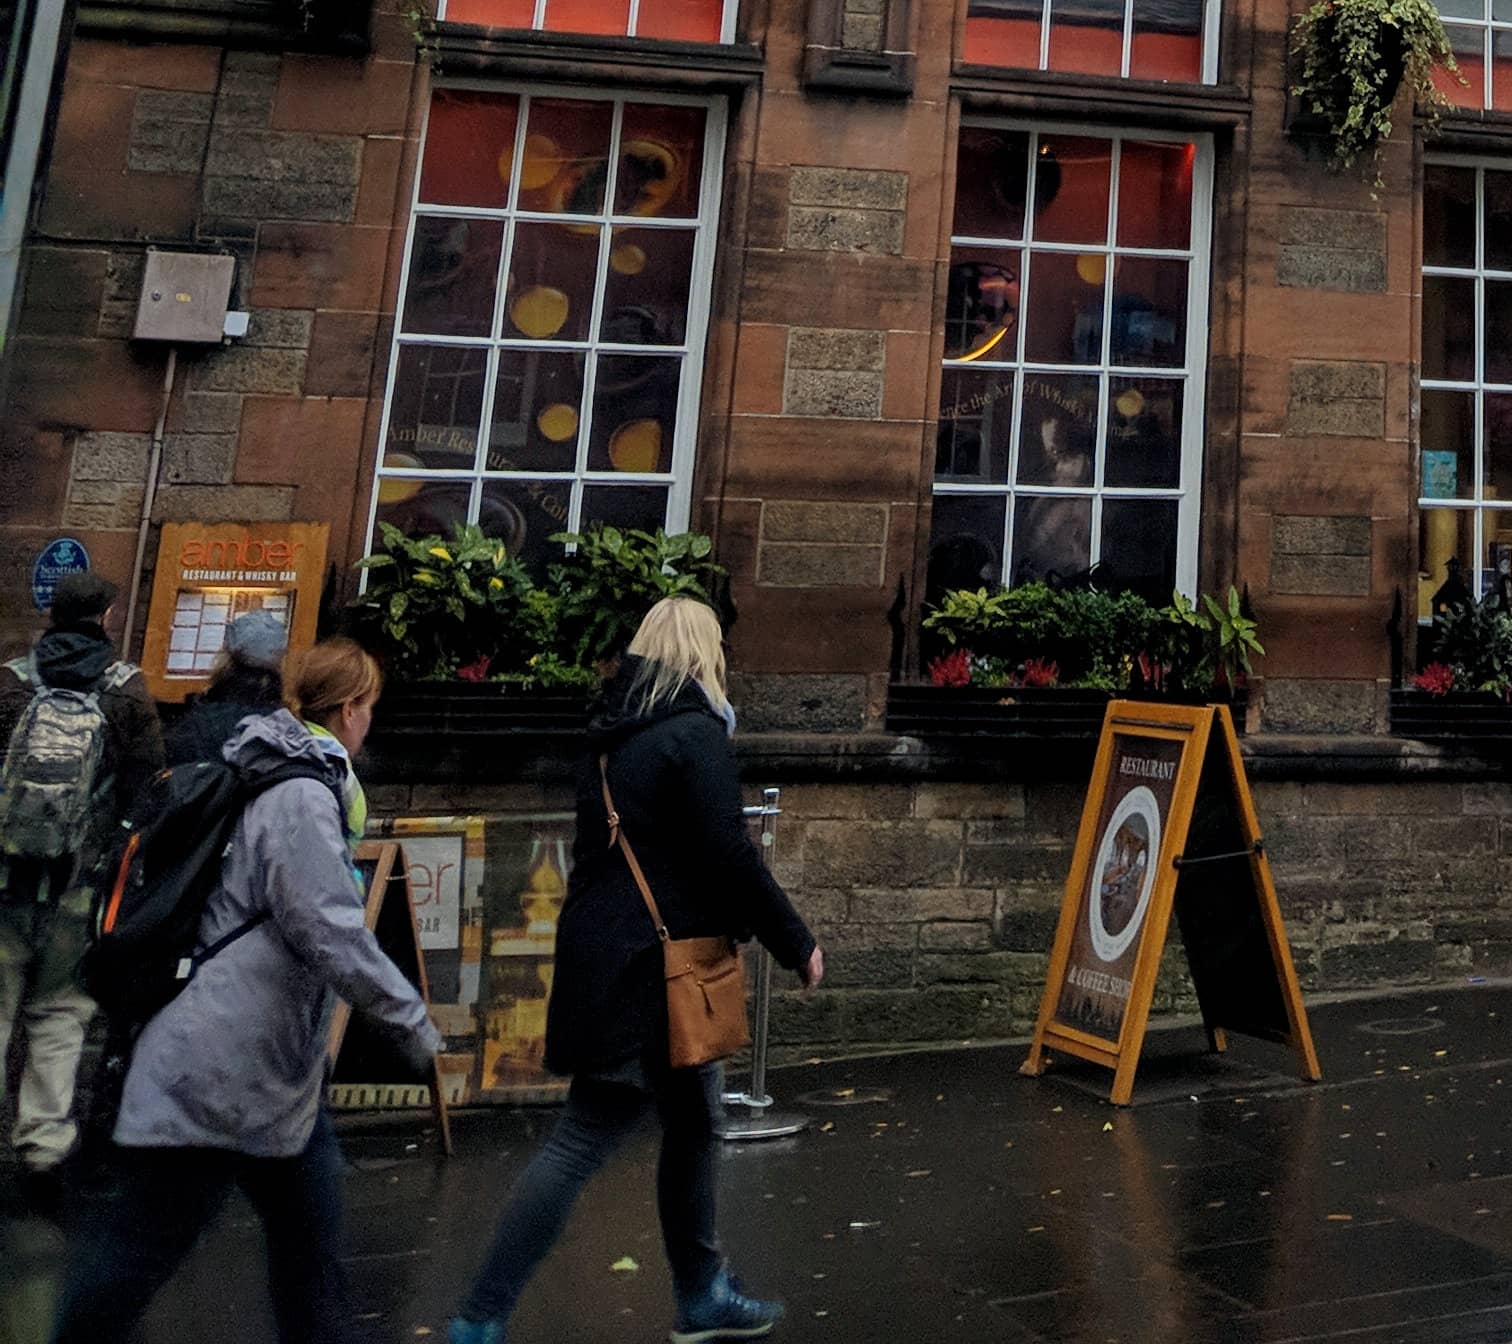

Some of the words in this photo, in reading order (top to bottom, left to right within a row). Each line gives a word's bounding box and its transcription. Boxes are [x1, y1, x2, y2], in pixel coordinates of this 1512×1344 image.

[180, 527, 305, 569] amber
[182, 569, 237, 581] RESTAURANT
[244, 570, 278, 582] WHISKY
[1119, 755, 1177, 781] RESTAURANT
[1076, 967, 1111, 994] COFFEE
